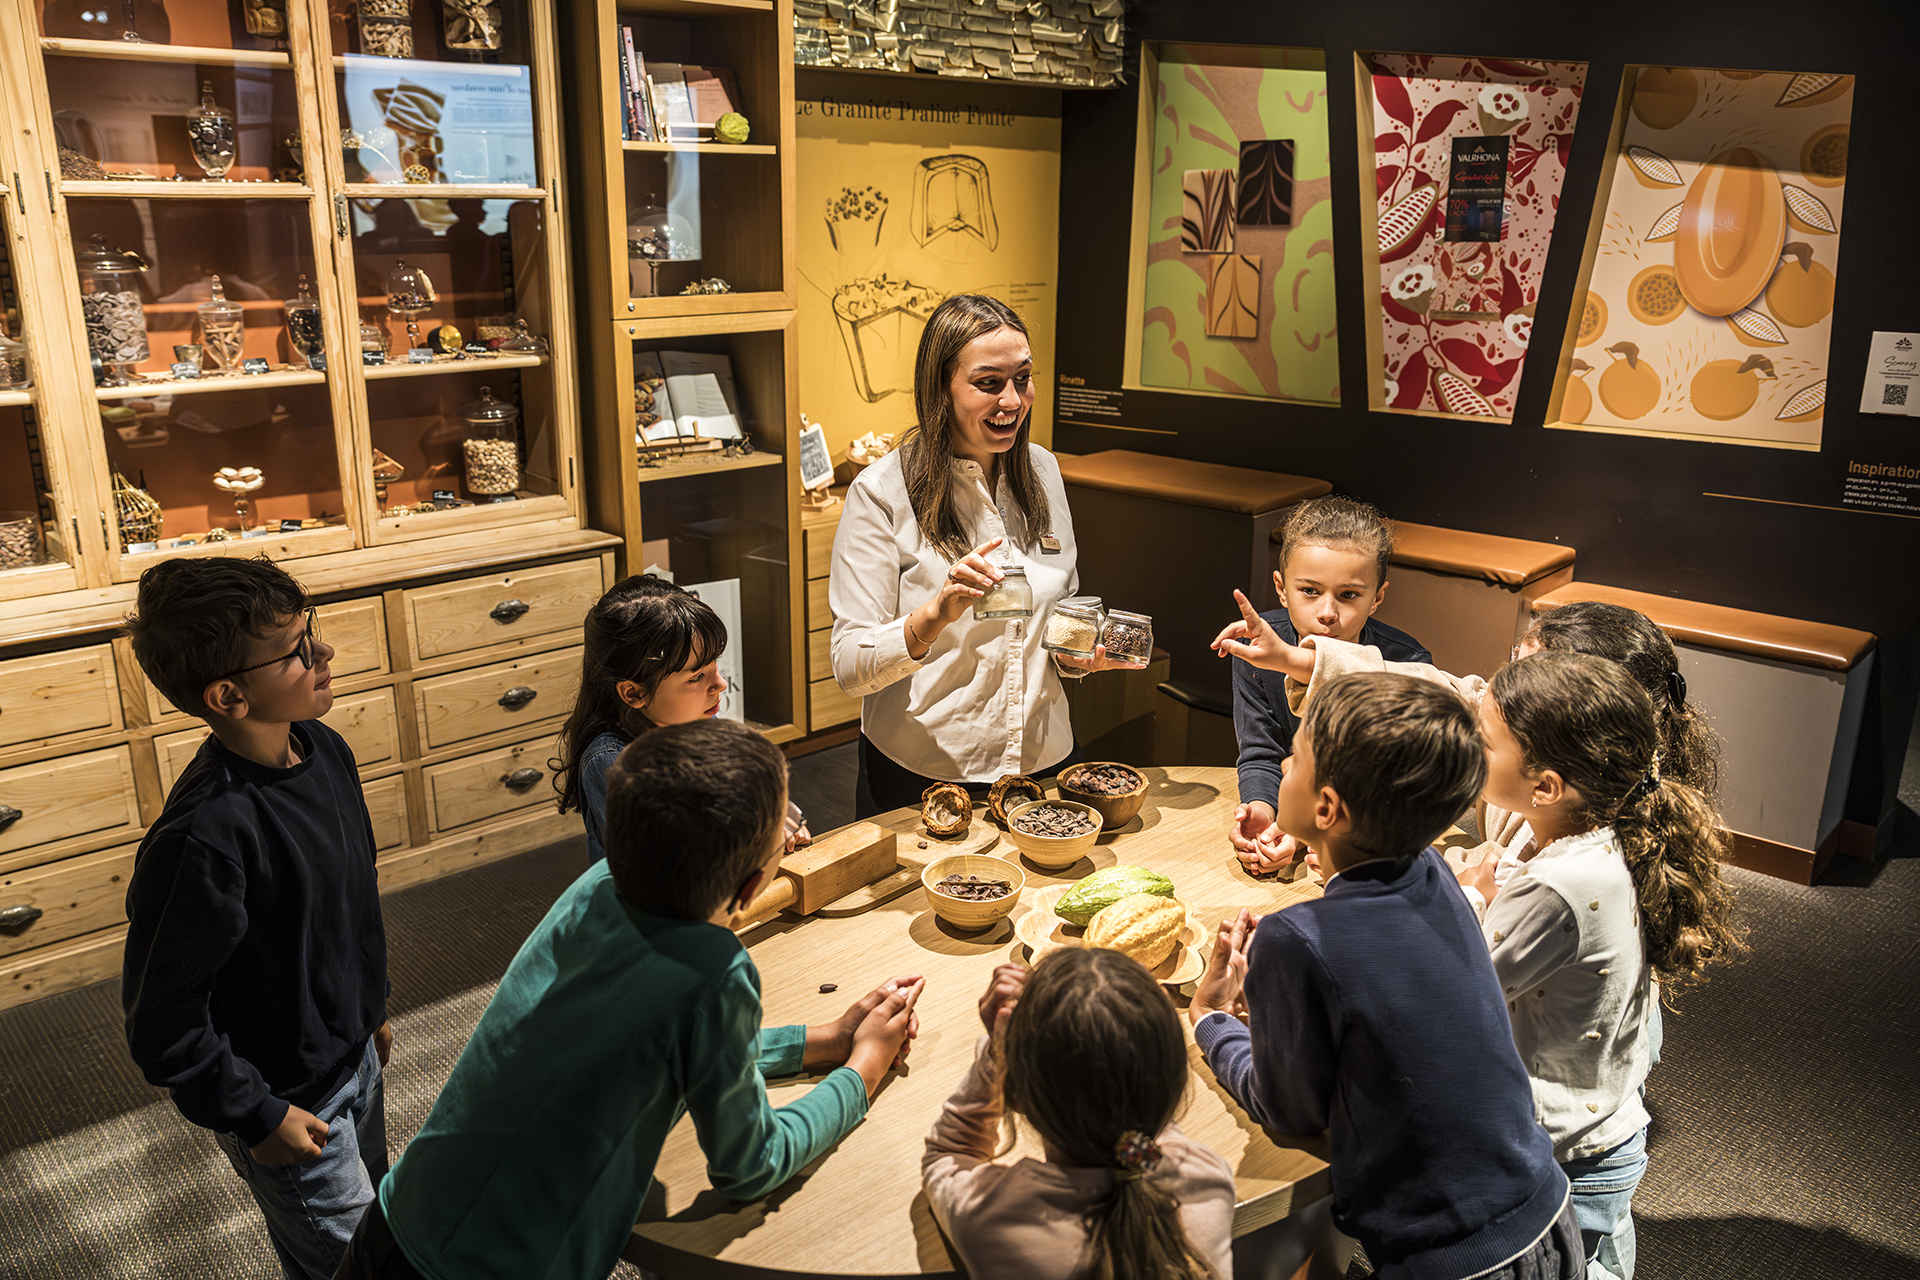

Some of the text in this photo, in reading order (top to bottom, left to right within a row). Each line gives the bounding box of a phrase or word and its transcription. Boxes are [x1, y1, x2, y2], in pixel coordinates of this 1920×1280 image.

[821, 95, 892, 120] Granité
[898, 100, 961, 124] Praliné
[966, 105, 1016, 127] Fruité
[1457, 153, 1501, 163] VALRHONA
[1449, 199, 1469, 210] 70%
